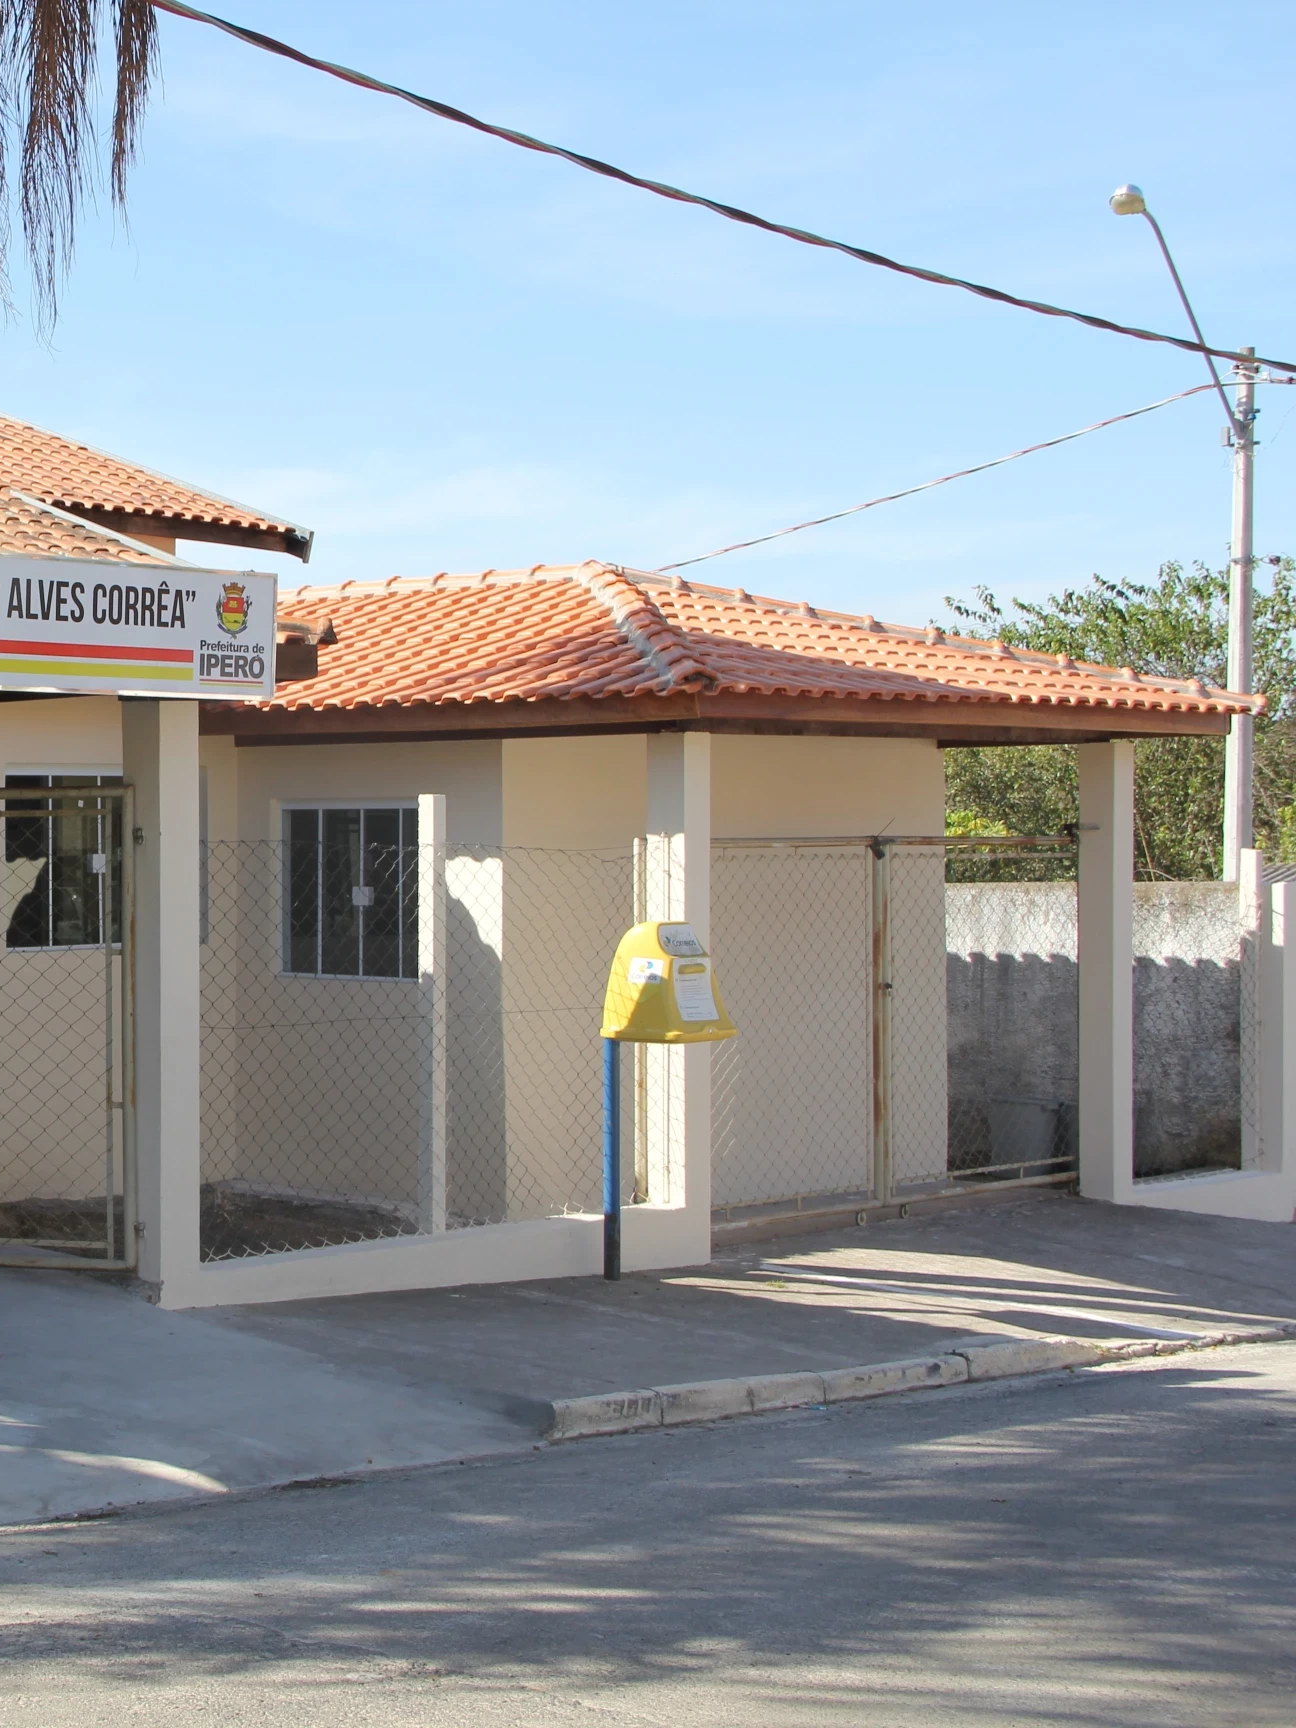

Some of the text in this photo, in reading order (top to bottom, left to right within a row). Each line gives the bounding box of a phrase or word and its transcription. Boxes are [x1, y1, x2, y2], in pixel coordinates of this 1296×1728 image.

[6, 577, 85, 623] ALVES
[92, 580, 196, 629] CORRÊA”
[199, 639, 265, 654] Prefeitura de
[199, 654, 265, 679] IPERÓ
[672, 939, 696, 947] Correios
